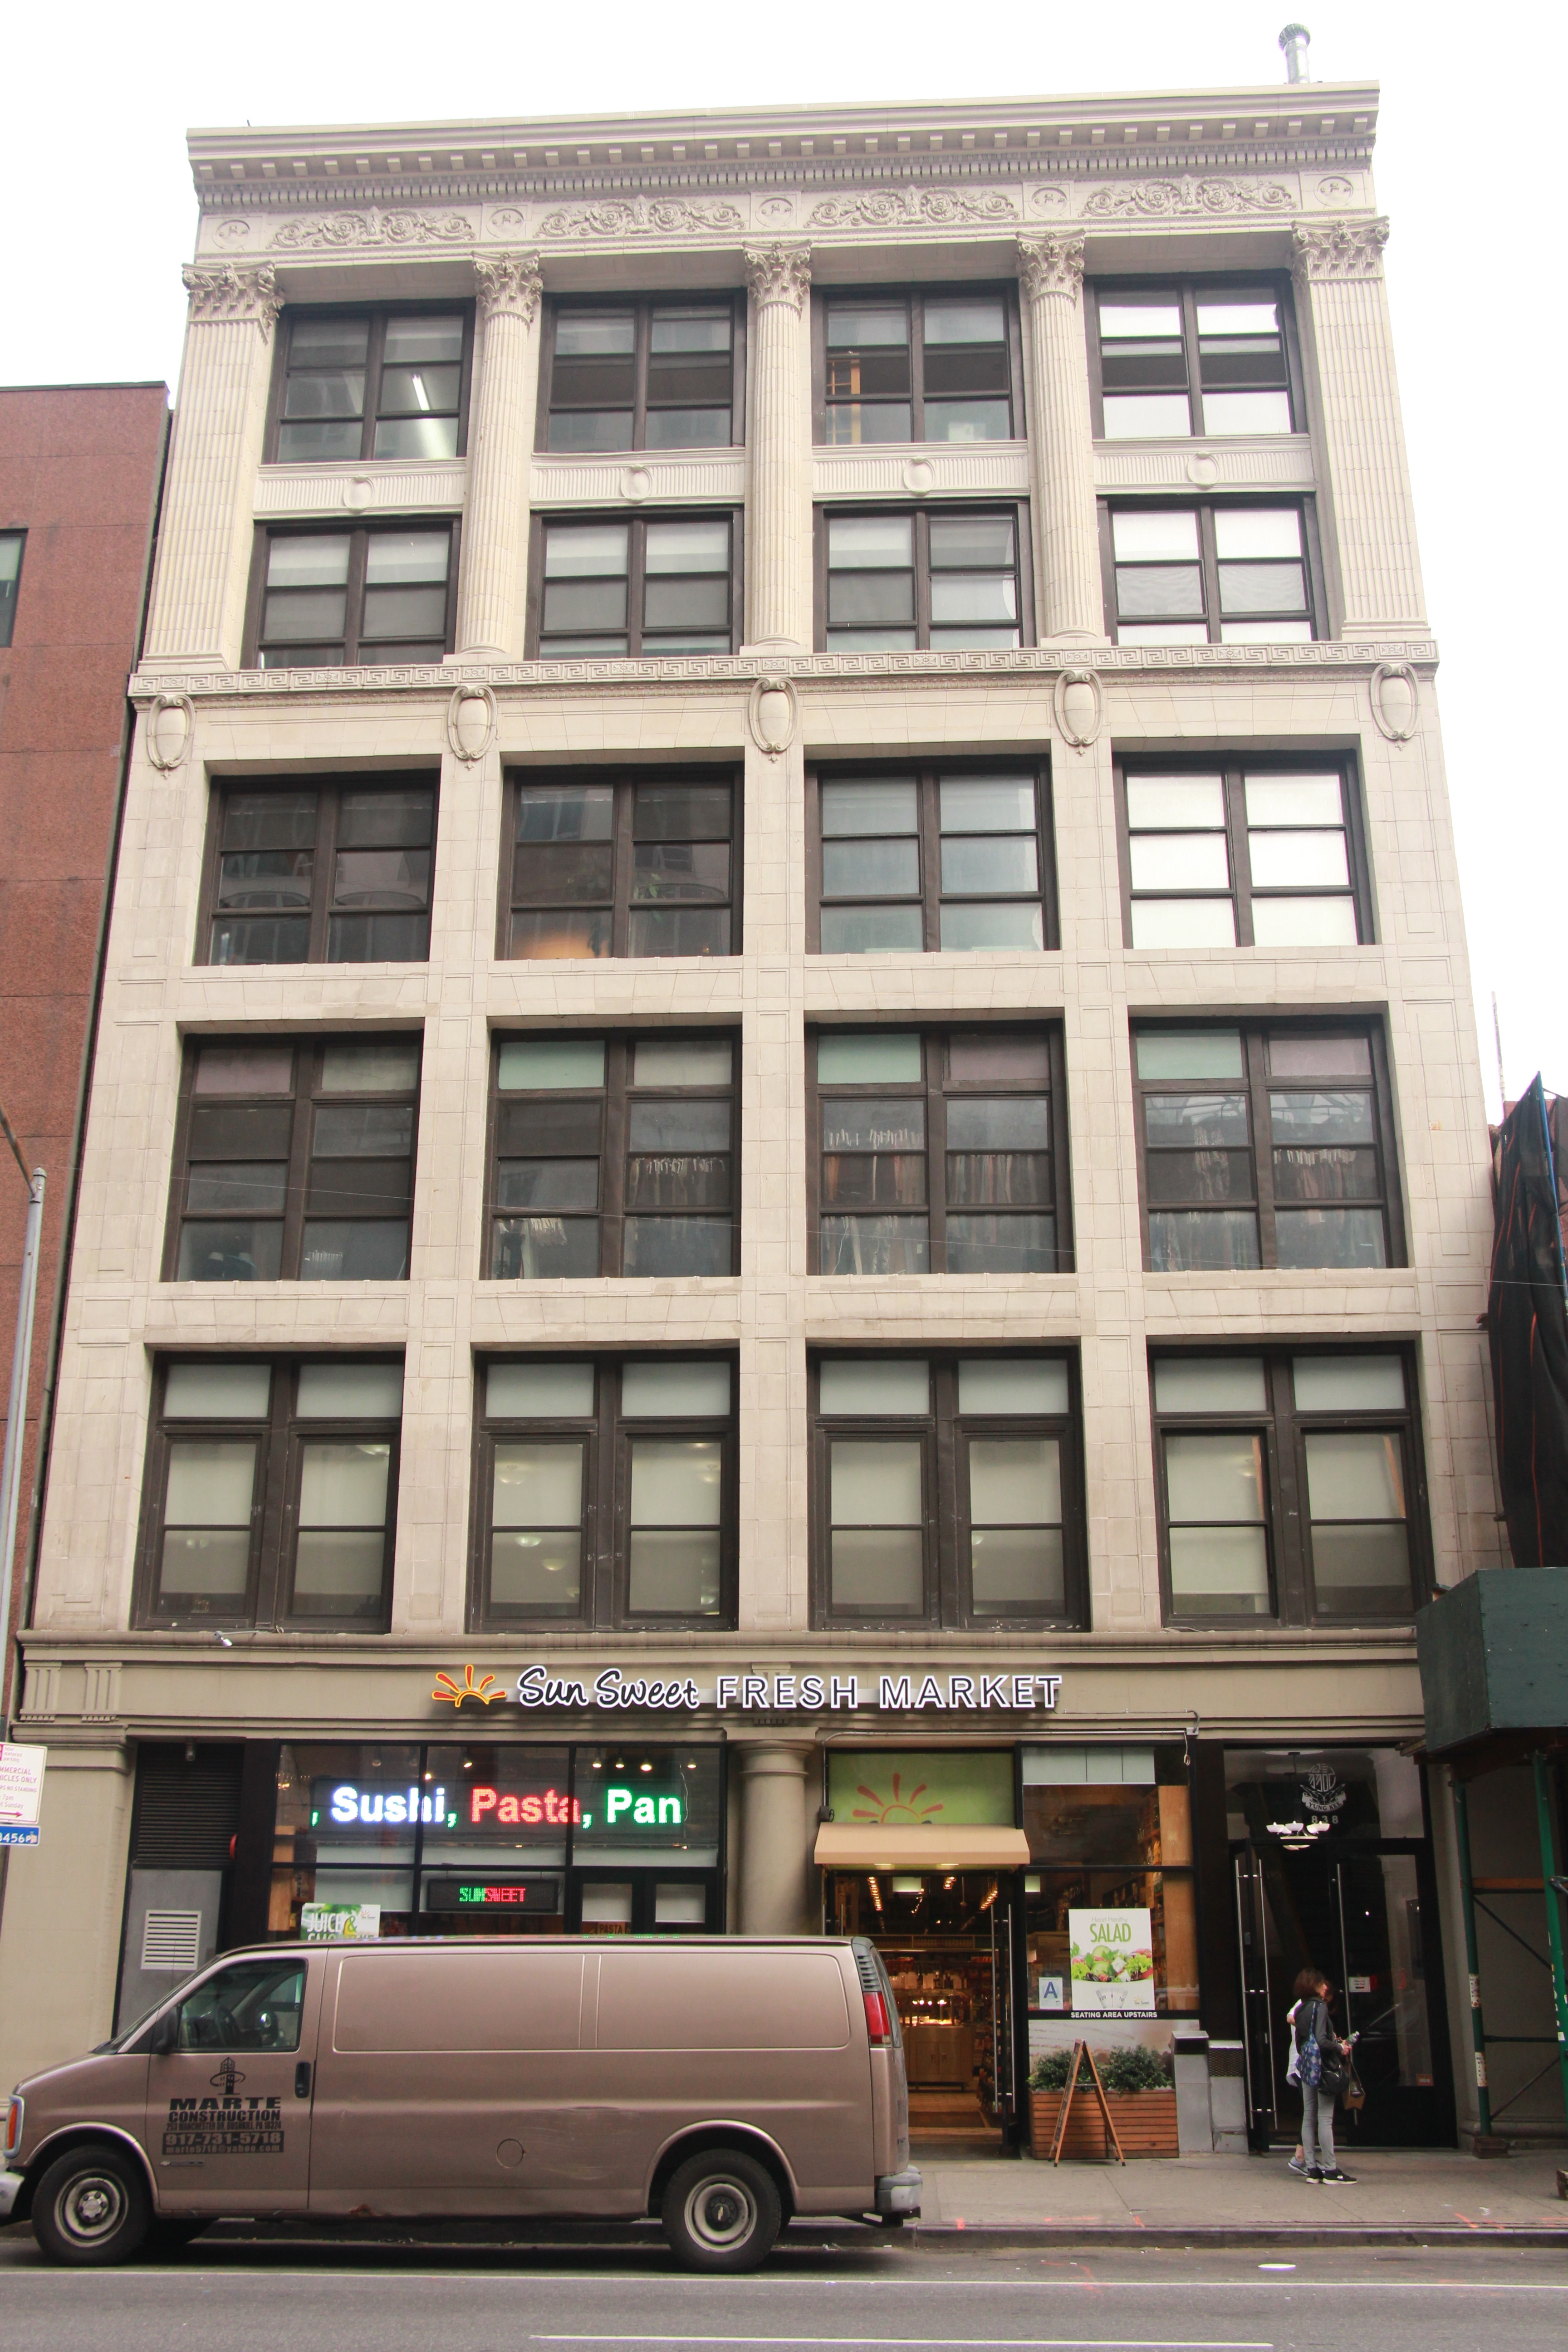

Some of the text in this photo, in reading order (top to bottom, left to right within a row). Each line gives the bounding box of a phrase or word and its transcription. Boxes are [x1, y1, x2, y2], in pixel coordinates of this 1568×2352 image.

[518, 1665, 1062, 1709] Sun Sweet FRESH MARKET
[5, 1801, 24, 1809] Sunday
[607, 1788, 682, 1824] Pan
[1309, 1801, 1342, 1810] YUNG KEE
[307, 1912, 358, 1932] JUICE &
[600, 1925, 622, 1934] PASTA
[1089, 1923, 1132, 1942] SALAD
[1044, 1982, 1058, 1999] A
[169, 2097, 281, 2110] MARTE
[169, 2110, 280, 2122] CONSTRUCTION
[166, 2122, 177, 2131] 253
[179, 2122, 216, 2131] MANCHESTER
[256, 2121, 263, 2130] PA
[166, 2132, 281, 2146] 917-731-5718
[166, 2145, 280, 2154] marte5718@yahoo.com
